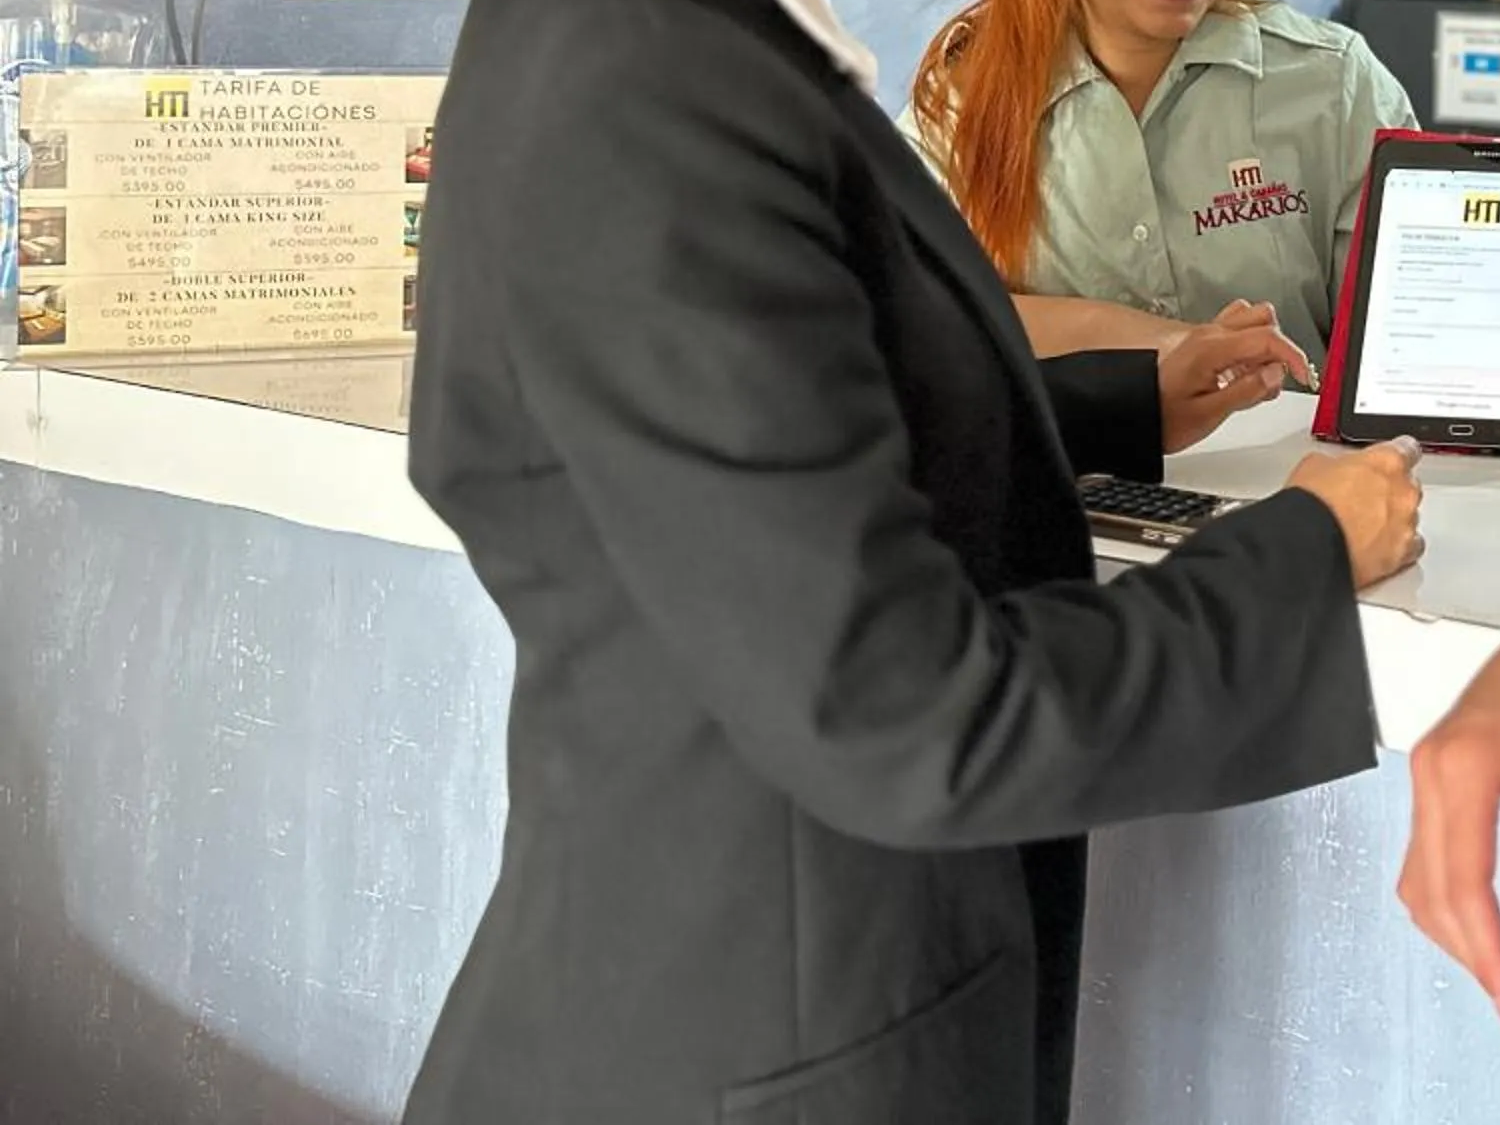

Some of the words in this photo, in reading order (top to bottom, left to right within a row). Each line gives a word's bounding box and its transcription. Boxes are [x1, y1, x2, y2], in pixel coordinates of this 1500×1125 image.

[291, 79, 322, 96] DE
[134, 138, 154, 149] DE
[176, 137, 224, 149] CAMA
[229, 136, 344, 148] MATRIMONIAL
[95, 153, 126, 163] CON
[130, 151, 212, 163] VENTILADOR
[295, 150, 325, 160] CON
[270, 162, 381, 173] ACONDICIONADO
[152, 213, 173, 225] DE
[195, 213, 241, 224] CAMA
[246, 212, 288, 223] KING
[291, 211, 326, 222] SIZE
[1192, 189, 1310, 236] MAKARIOS
[135, 228, 218, 239] VENTILADOR
[293, 226, 323, 235] CON
[269, 236, 380, 248] ACONDICIONADO
[117, 292, 139, 304] DE
[162, 290, 219, 302] CAMAS
[223, 286, 357, 301] MATRIMONIALES
[101, 307, 132, 318] CON
[134, 305, 217, 317] VENTILADOR
[268, 311, 379, 324] ACONDICIONADO
